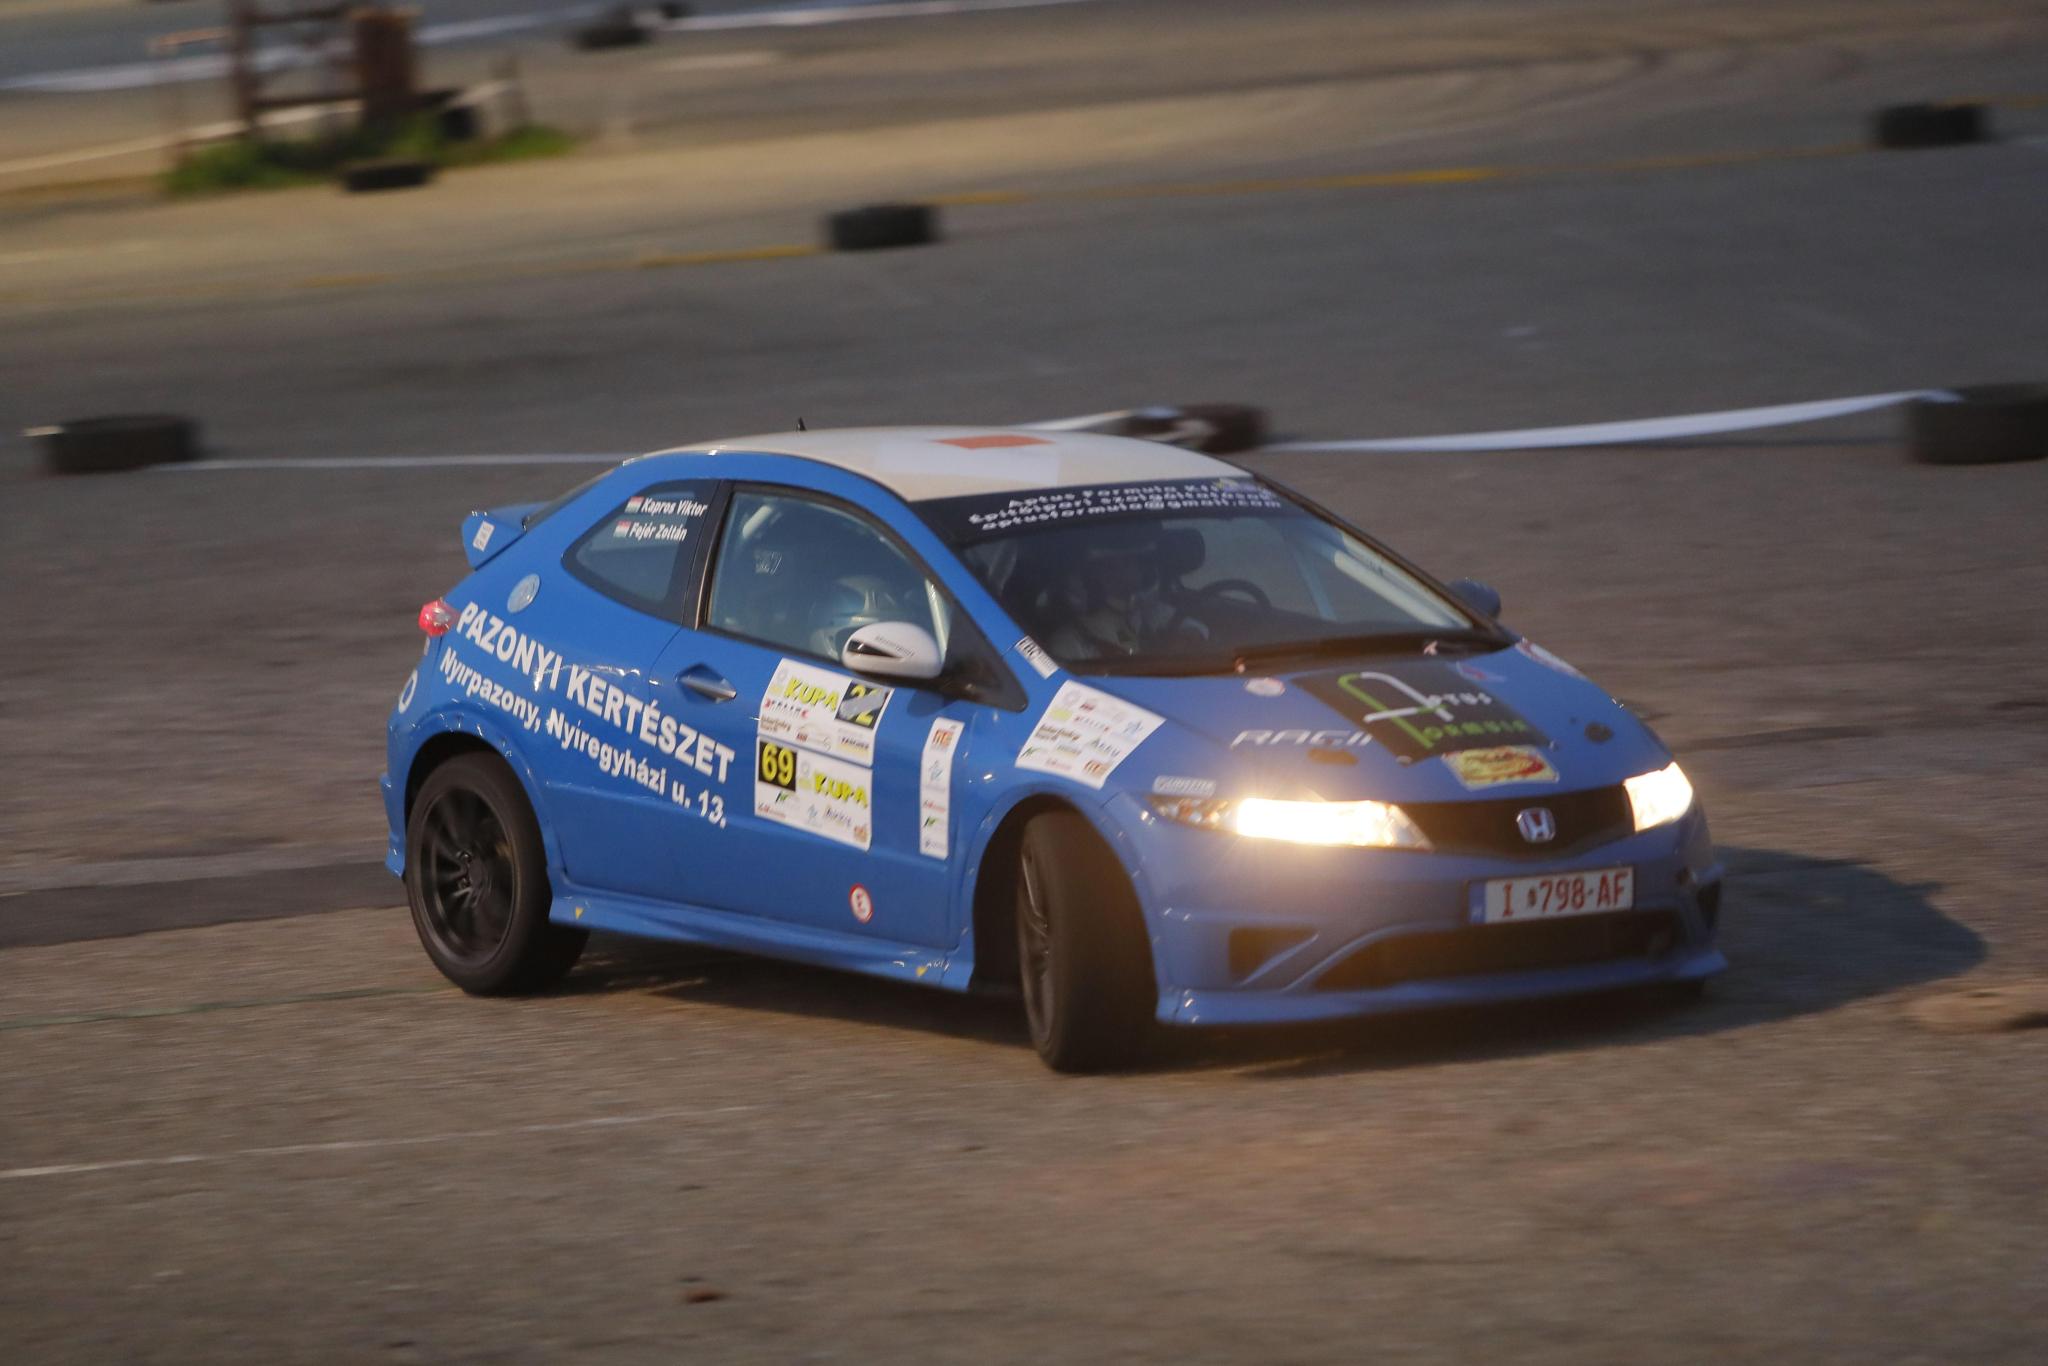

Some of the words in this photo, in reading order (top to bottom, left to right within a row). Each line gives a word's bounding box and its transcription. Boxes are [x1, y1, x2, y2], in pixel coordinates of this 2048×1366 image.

[641, 498, 676, 516] Kapros
[677, 500, 708, 518] Viktor
[655, 523, 688, 541] Zoltán
[456, 602, 563, 692] PAZONYI
[566, 664, 736, 784] KERTÉSZET
[783, 677, 840, 713] KUPA
[546, 707, 667, 796] Nyíregyházi
[671, 780, 691, 809] u.
[698, 790, 727, 828] 13.
[761, 742, 795, 787] 69
[814, 771, 869, 810] KUPA
[1538, 871, 1629, 914] 798-AF
